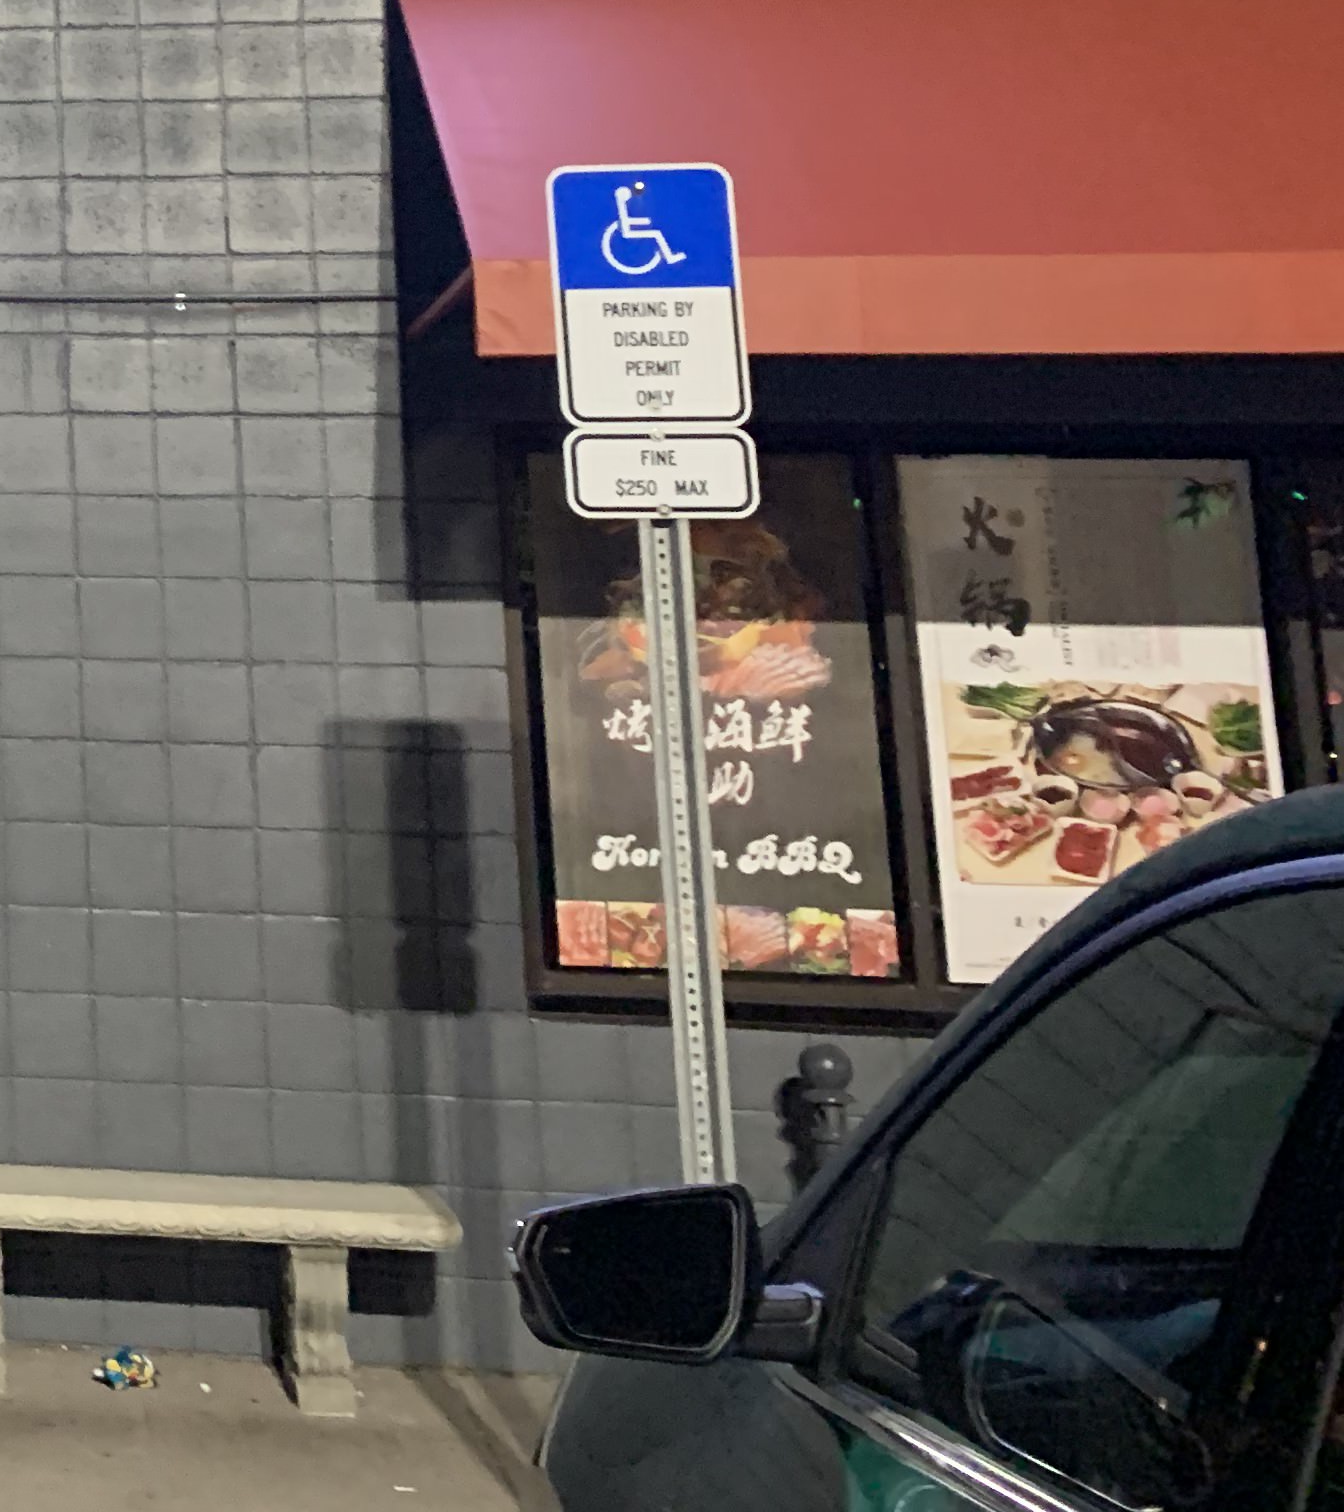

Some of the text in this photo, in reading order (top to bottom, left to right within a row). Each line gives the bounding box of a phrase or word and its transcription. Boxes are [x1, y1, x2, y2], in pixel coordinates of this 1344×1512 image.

[601, 300, 694, 318] PARKING BY
[613, 330, 690, 348] DISABLED
[624, 359, 682, 377] PERMIT
[635, 389, 675, 407] ONLY
[640, 449, 678, 467] FINE
[615, 478, 710, 498] $250 MAX
[602, 698, 813, 763] 烤海鲜
[591, 833, 863, 885] Korn BBQ
